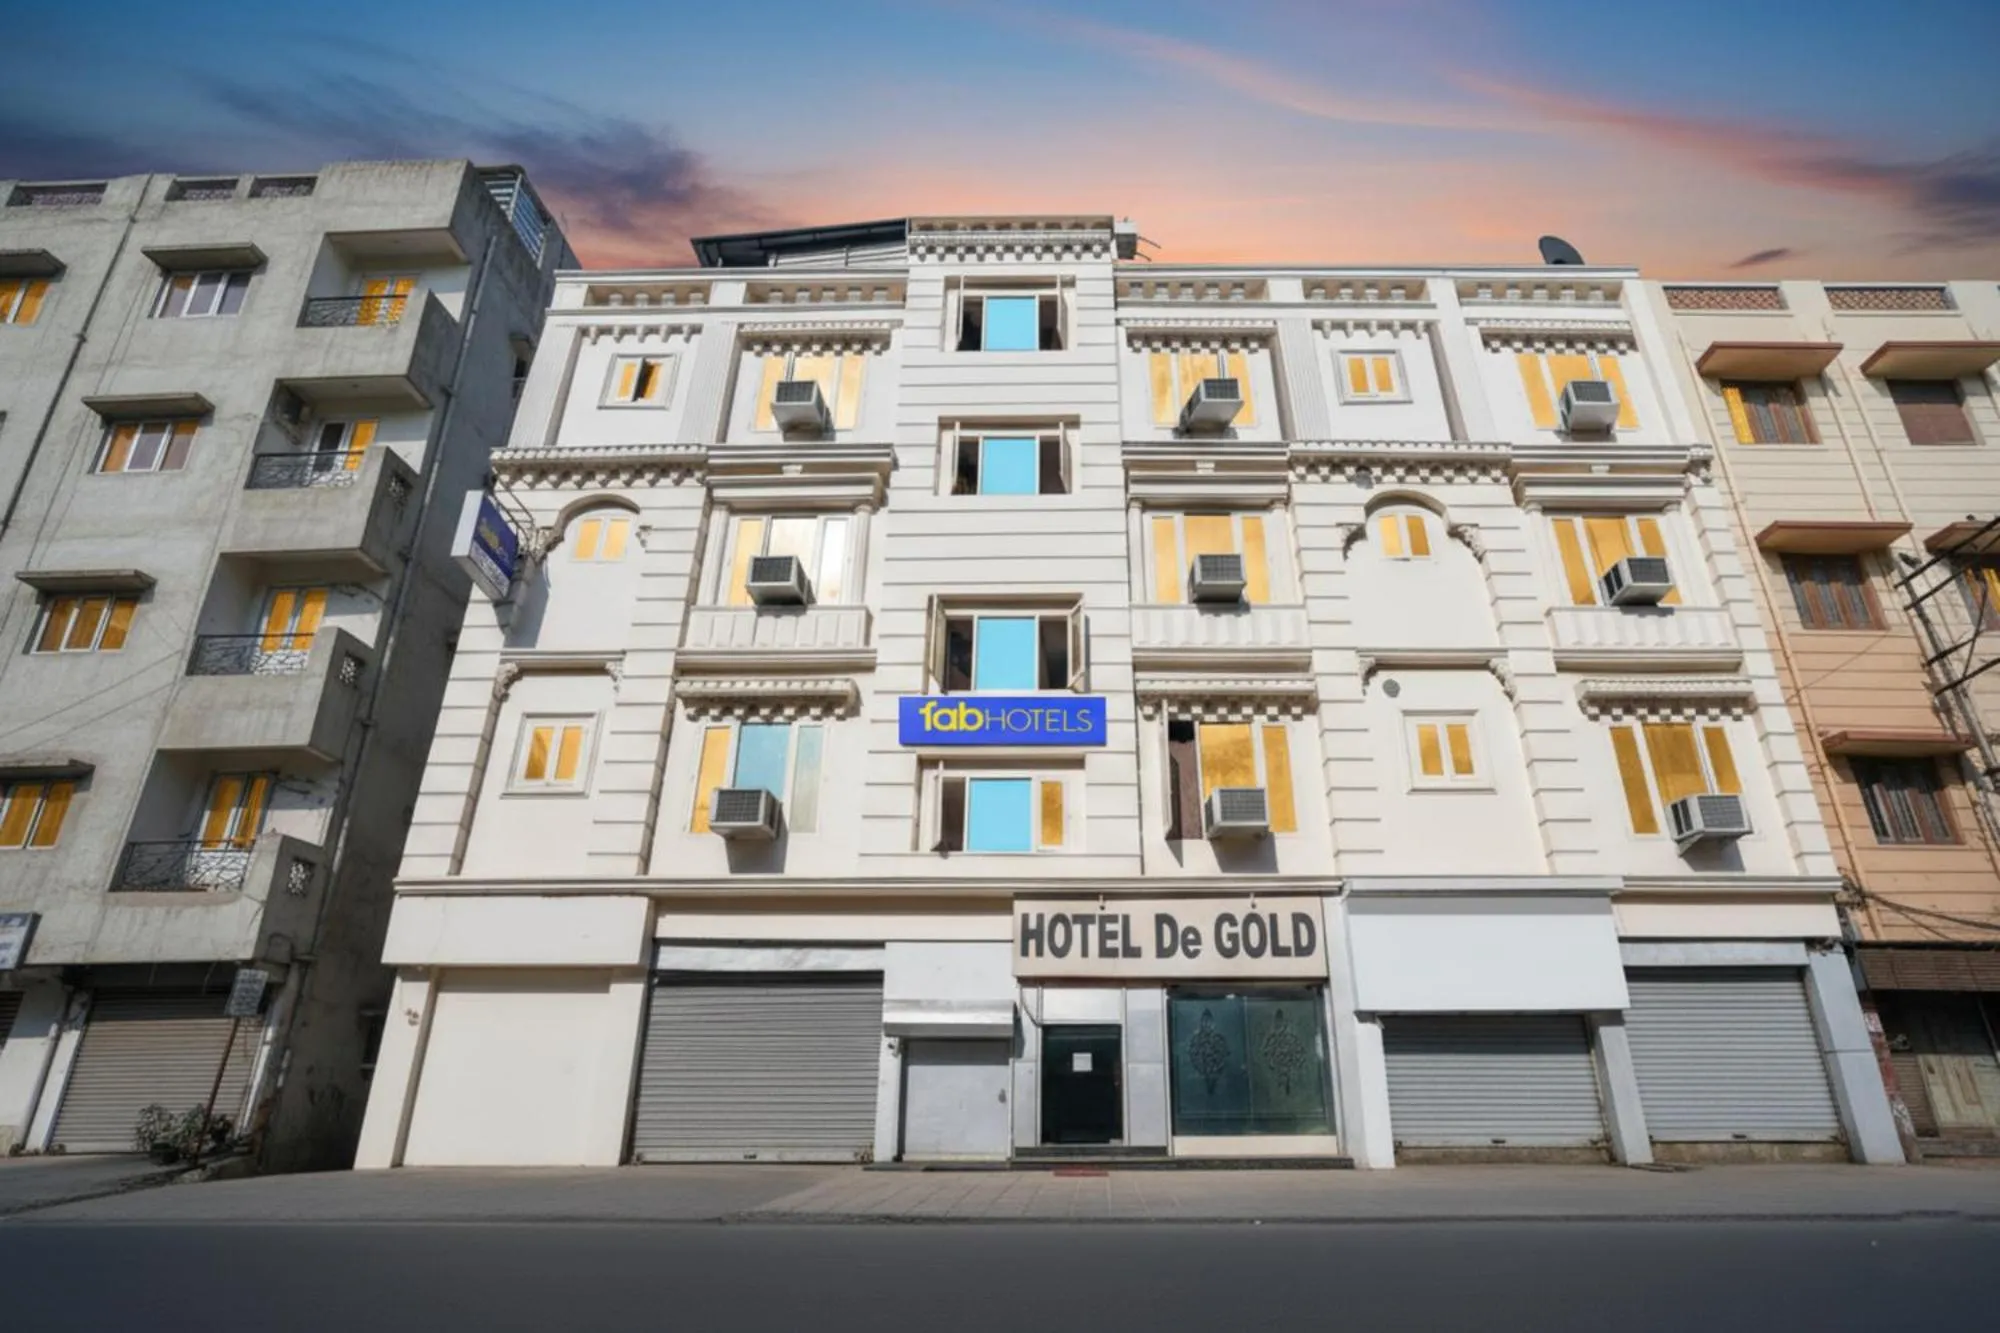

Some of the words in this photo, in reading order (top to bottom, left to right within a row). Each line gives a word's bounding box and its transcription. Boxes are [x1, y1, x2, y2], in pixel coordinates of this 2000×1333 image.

[1020, 912, 1142, 959] HOTEL
[1154, 912, 1202, 959] De
[1213, 912, 1317, 960] GOLD
